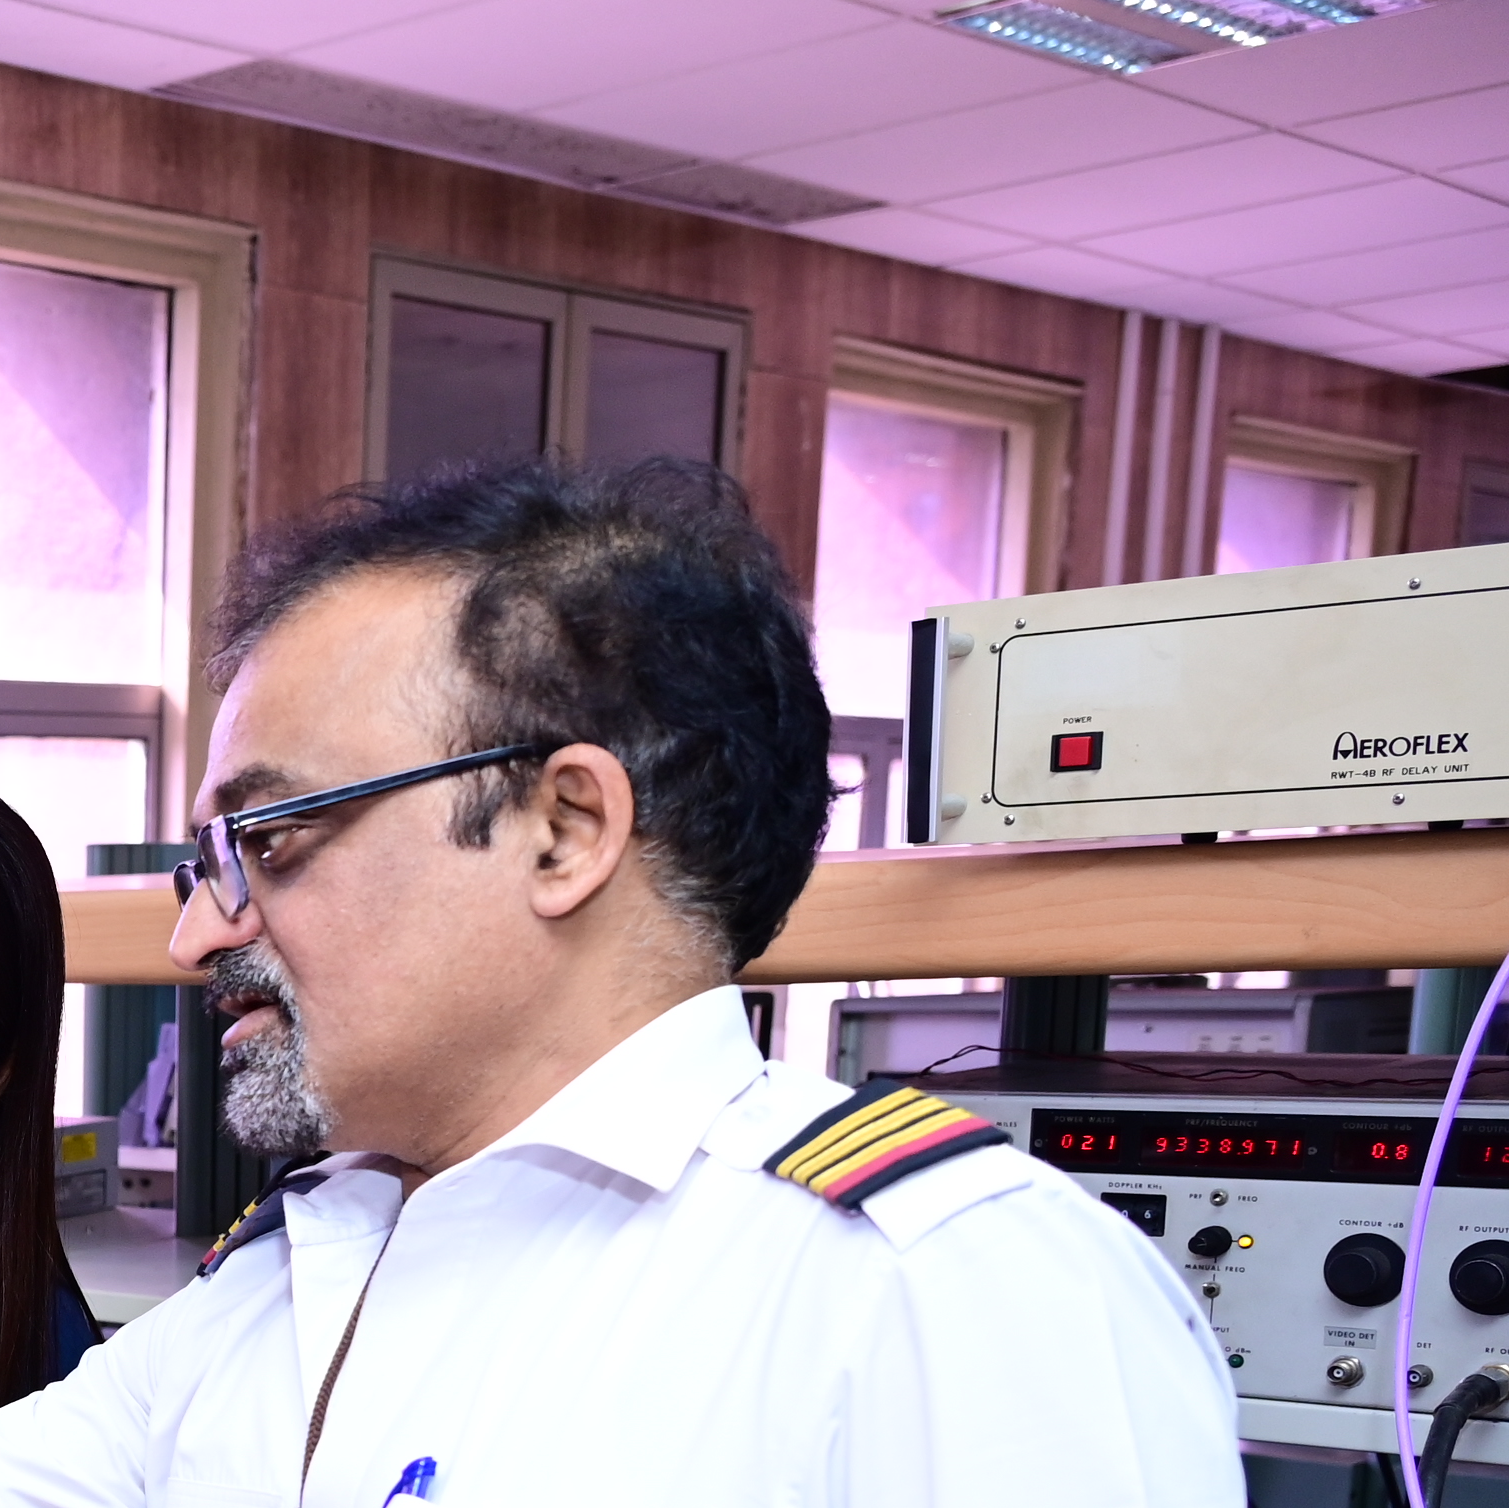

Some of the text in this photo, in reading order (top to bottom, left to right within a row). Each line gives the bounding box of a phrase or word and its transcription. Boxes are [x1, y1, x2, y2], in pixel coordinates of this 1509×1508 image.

[1062, 715, 1093, 725] POWER
[1332, 731, 1469, 760] AEROFLEX
[1331, 764, 1470, 779] RWT-4B RF DELAY UNIT
[1089, 1116, 1116, 1124] WATTS
[1185, 1118, 1258, 1127] PRF/FREQUENCY
[1342, 1122, 1389, 1130] CONTOUR
[1061, 1134, 1116, 1151] 021
[1371, 1142, 1409, 1160] 0.8
[1339, 1219, 1382, 1227] CONTOUR
[1185, 1264, 1221, 1272] MANUAL
[1327, 1330, 1375, 1340] VIDEO DET
